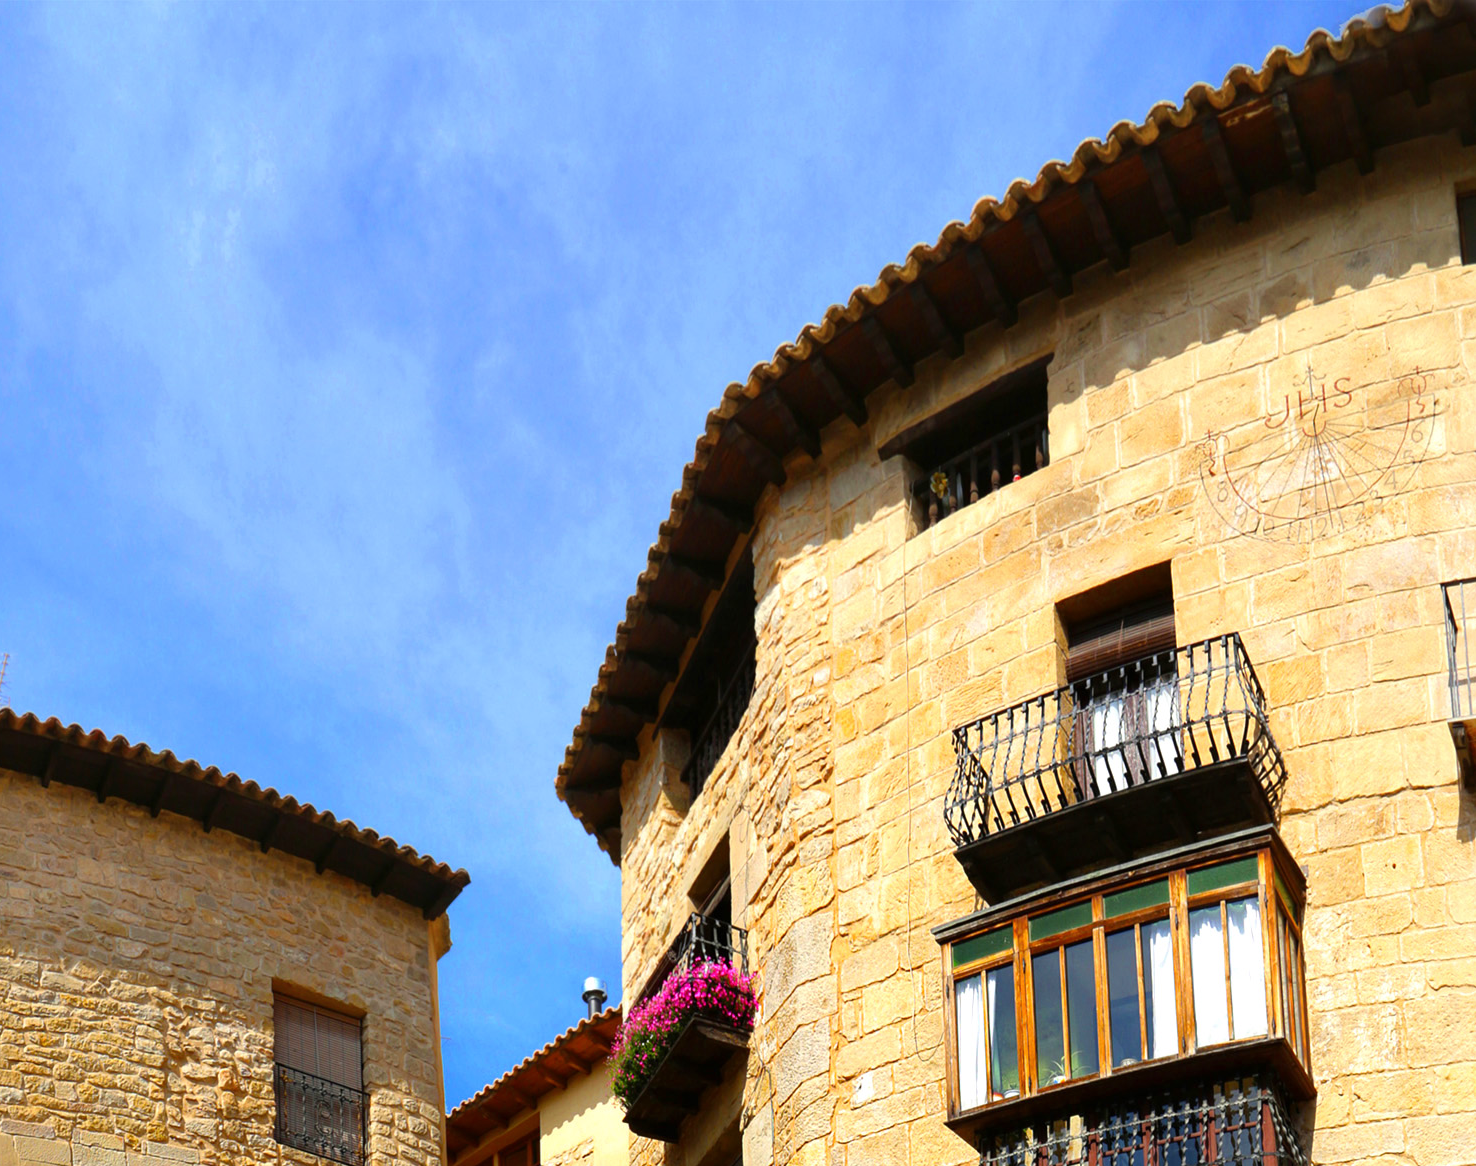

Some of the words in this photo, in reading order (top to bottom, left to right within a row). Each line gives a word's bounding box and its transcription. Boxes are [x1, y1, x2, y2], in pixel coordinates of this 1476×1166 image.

[1410, 419, 1427, 443] 6
[1217, 480, 1229, 503] 8
[1383, 470, 1398, 490] 4
[1234, 502, 1249, 529] 9
[1310, 516, 1328, 541] 12
